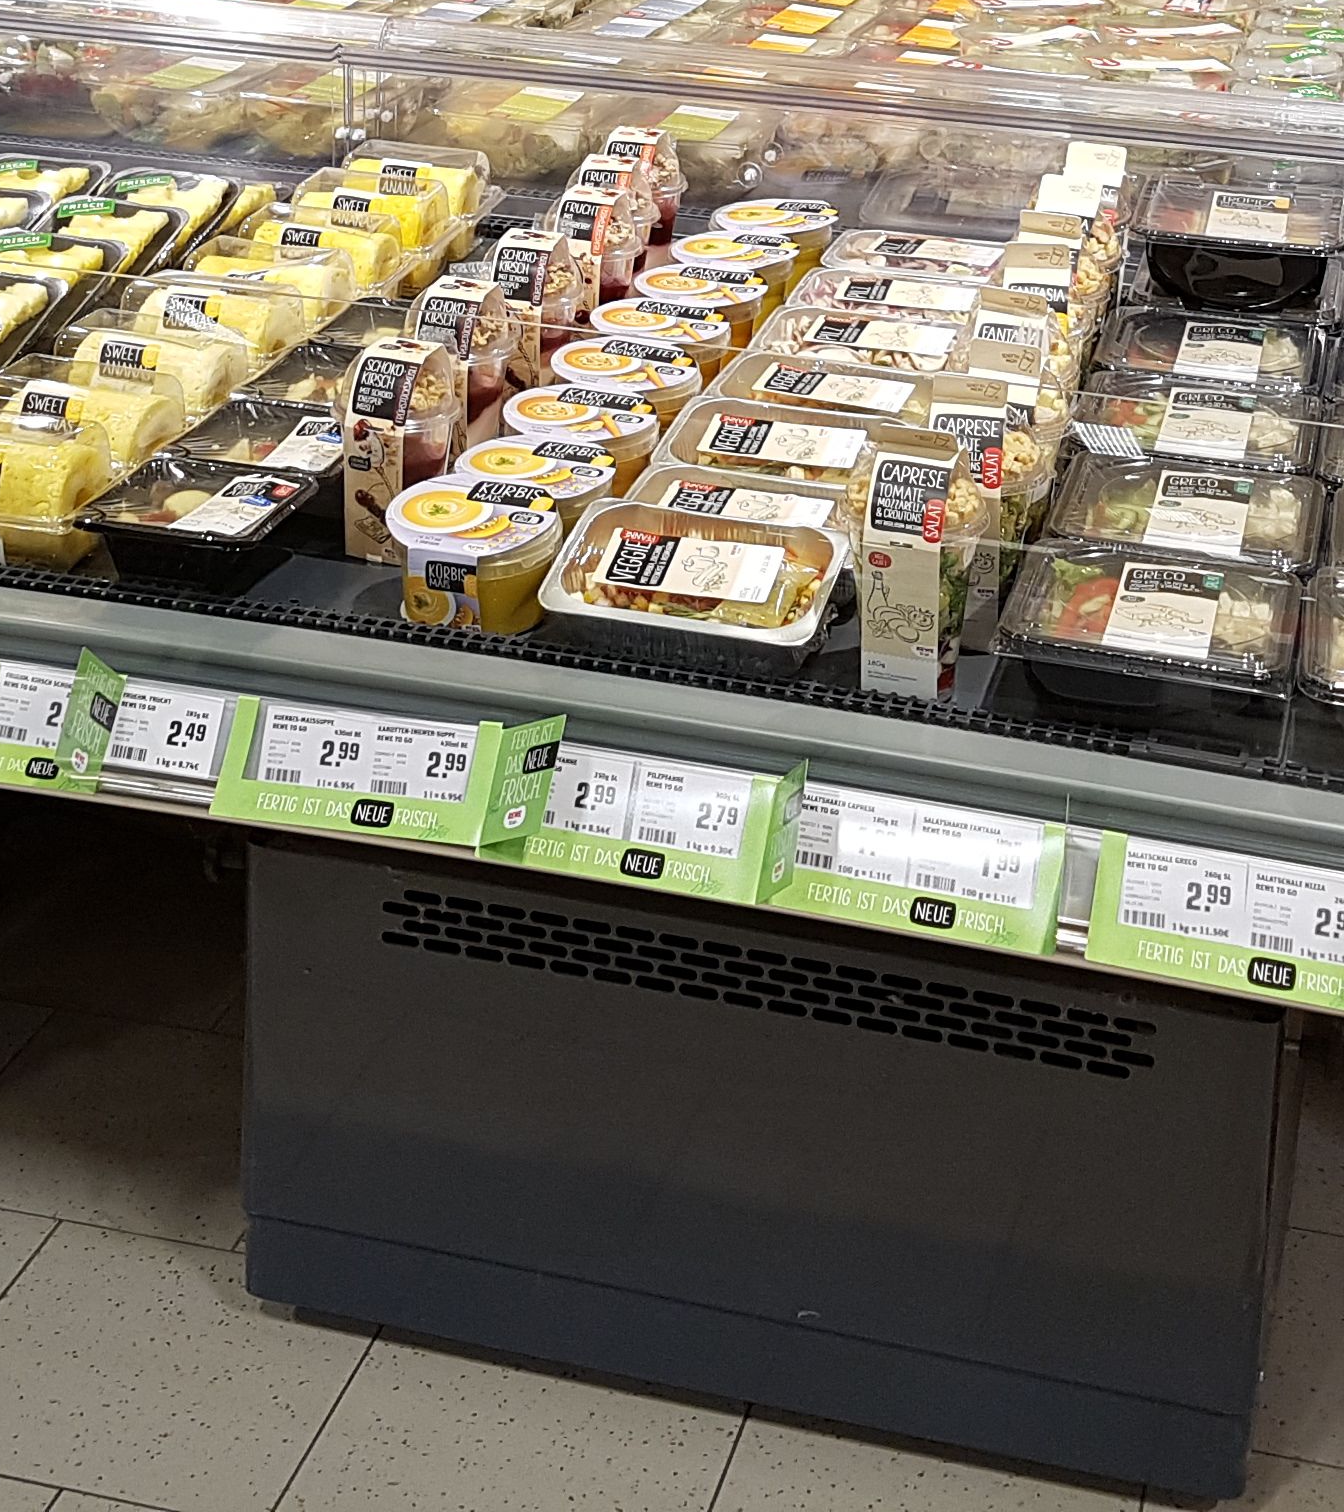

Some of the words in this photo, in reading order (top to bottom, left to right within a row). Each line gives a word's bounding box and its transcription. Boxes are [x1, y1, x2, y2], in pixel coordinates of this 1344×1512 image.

[611, 142, 643, 156] FRUCHT
[564, 201, 600, 216] FRUCHT
[429, 298, 468, 315] SCHOKO-
[641, 300, 716, 318] KAROTTEN
[424, 312, 457, 328] KIRSCH
[104, 343, 142, 362] SWEET
[608, 341, 684, 360] KAROTTEN
[365, 358, 407, 377] SCHOKO-
[361, 372, 396, 390] KIRSCH
[27, 393, 66, 415] SWEET
[561, 388, 644, 407] KAROTTEN
[936, 415, 999, 438] CAPRESE
[543, 442, 607, 460] KÜRBIS
[881, 463, 947, 489] CAPRESE
[985, 453, 999, 484] SALAT
[478, 482, 544, 501] KÜRBIS
[1169, 476, 1219, 489] GRECO
[879, 483, 924, 502] TOMATE
[877, 497, 926, 513] MOZZARELLA
[883, 509, 922, 523] CROUTONS
[925, 504, 940, 538] SALAT
[608, 539, 652, 581] VEGGIE
[428, 562, 468, 582] KÜRBIS
[1132, 569, 1186, 582] GRECO
[166, 720, 206, 748] 2.49
[320, 740, 360, 768] 2.99
[506, 753, 522, 773] DAS
[526, 748, 550, 770] NEUE
[29, 761, 55, 777] NEUE
[426, 751, 467, 779] 2.99
[574, 782, 616, 811] 2.99
[257, 793, 296, 813] FERTIG
[302, 797, 320, 816] IST
[326, 801, 350, 819] DAS
[355, 804, 390, 824] NEUE
[696, 802, 738, 831] 2.79
[524, 836, 565, 857] FERTIG
[570, 842, 589, 862] IST
[594, 848, 620, 868] DAS
[624, 854, 661, 876] NEUE
[1128, 851, 1173, 864] SALATSCHALE
[1175, 857, 1197, 866] GRECO
[1256, 873, 1303, 888] SALATSCHALE
[808, 883, 850, 906] FERTIG
[857, 891, 877, 910] IST
[882, 896, 910, 916] DAS
[915, 902, 951, 925] NEUE
[1185, 882, 1231, 913] 2.99
[1138, 941, 1183, 966] FERTIG
[1191, 950, 1211, 970] IST
[1218, 956, 1246, 977] DAS
[1252, 964, 1293, 987] NEUE
